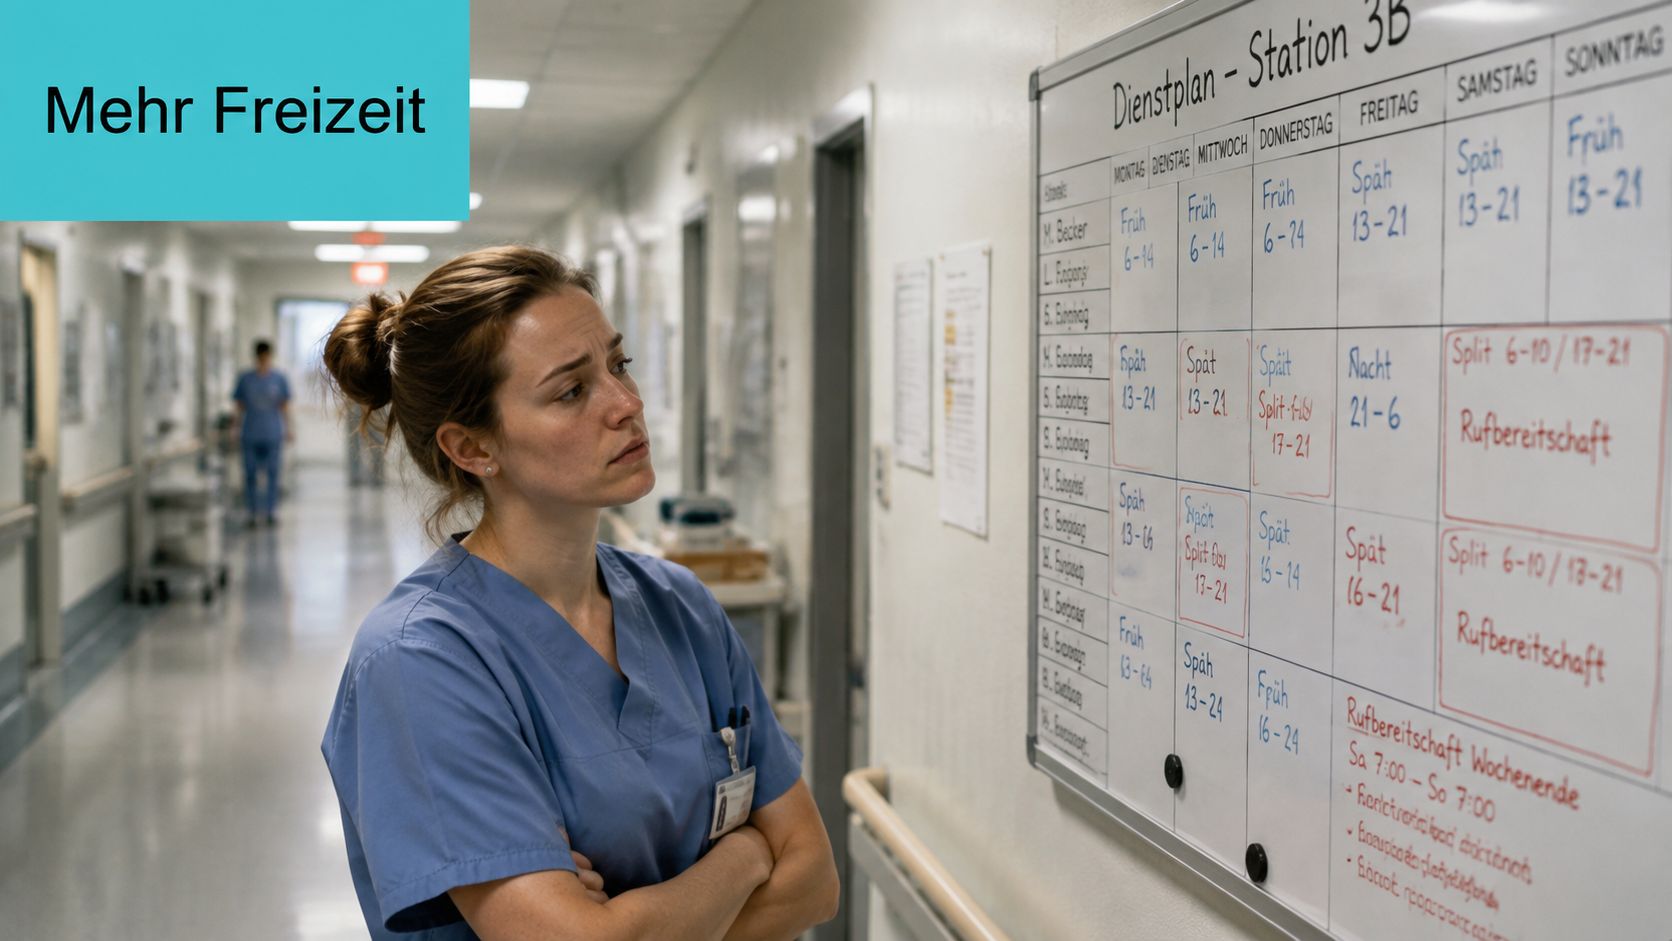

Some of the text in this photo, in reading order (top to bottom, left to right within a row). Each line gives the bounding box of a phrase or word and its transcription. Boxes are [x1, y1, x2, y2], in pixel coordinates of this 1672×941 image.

[1113, 57, 1215, 128] Dienstplan
[1249, 17, 1348, 88] Station
[1364, 0, 1412, 53] 3B
[1114, 25, 1665, 185] MONTAG DIENSTAG MITTWOCH DONNERSTAG FREITAG SAMSTAG SONNTAG
[1567, 112, 1623, 165] Früh
[1188, 193, 1217, 222] Früh
[1263, 178, 1295, 210] Früh
[1057, 216, 1088, 243] Becker
[1349, 346, 1391, 380] Nacht
[1453, 336, 1492, 375] Split
[1460, 408, 1612, 466] Rufbereitschaft
[1346, 526, 1386, 571] Spät
[1449, 536, 1488, 575] Split
[1458, 611, 1606, 687] Rufbereitschaft
[1347, 696, 1580, 811] Rufbereitschaft Wochenende
[1349, 741, 1367, 770] Sa
[1374, 752, 1406, 783] 7:00
[1428, 773, 1447, 803] So
[1456, 785, 1496, 822] 7:00
